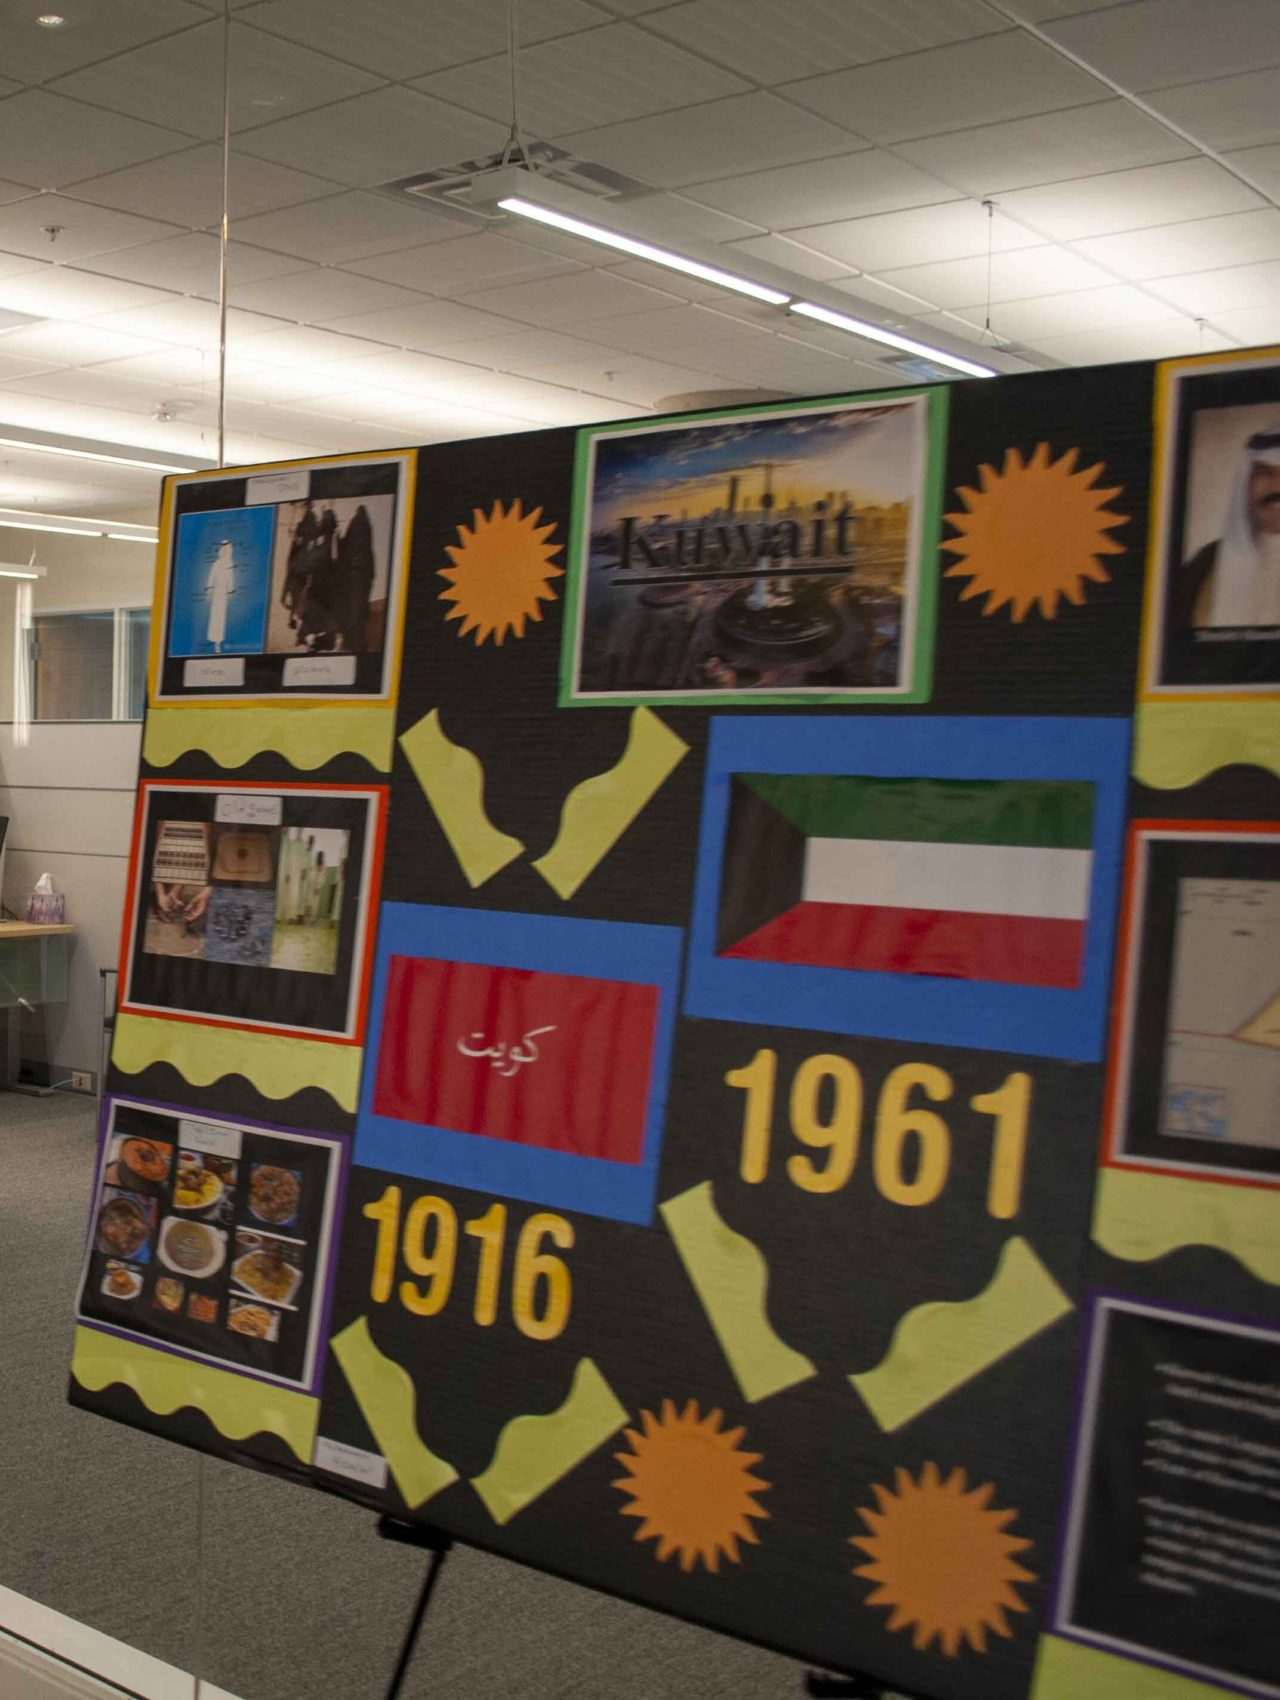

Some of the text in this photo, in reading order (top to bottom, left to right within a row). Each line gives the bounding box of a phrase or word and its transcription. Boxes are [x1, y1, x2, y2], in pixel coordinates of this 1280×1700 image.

[617, 499, 858, 570] Kuwait
[725, 1048, 1032, 1219] 1961
[364, 1186, 575, 1341] 1916
